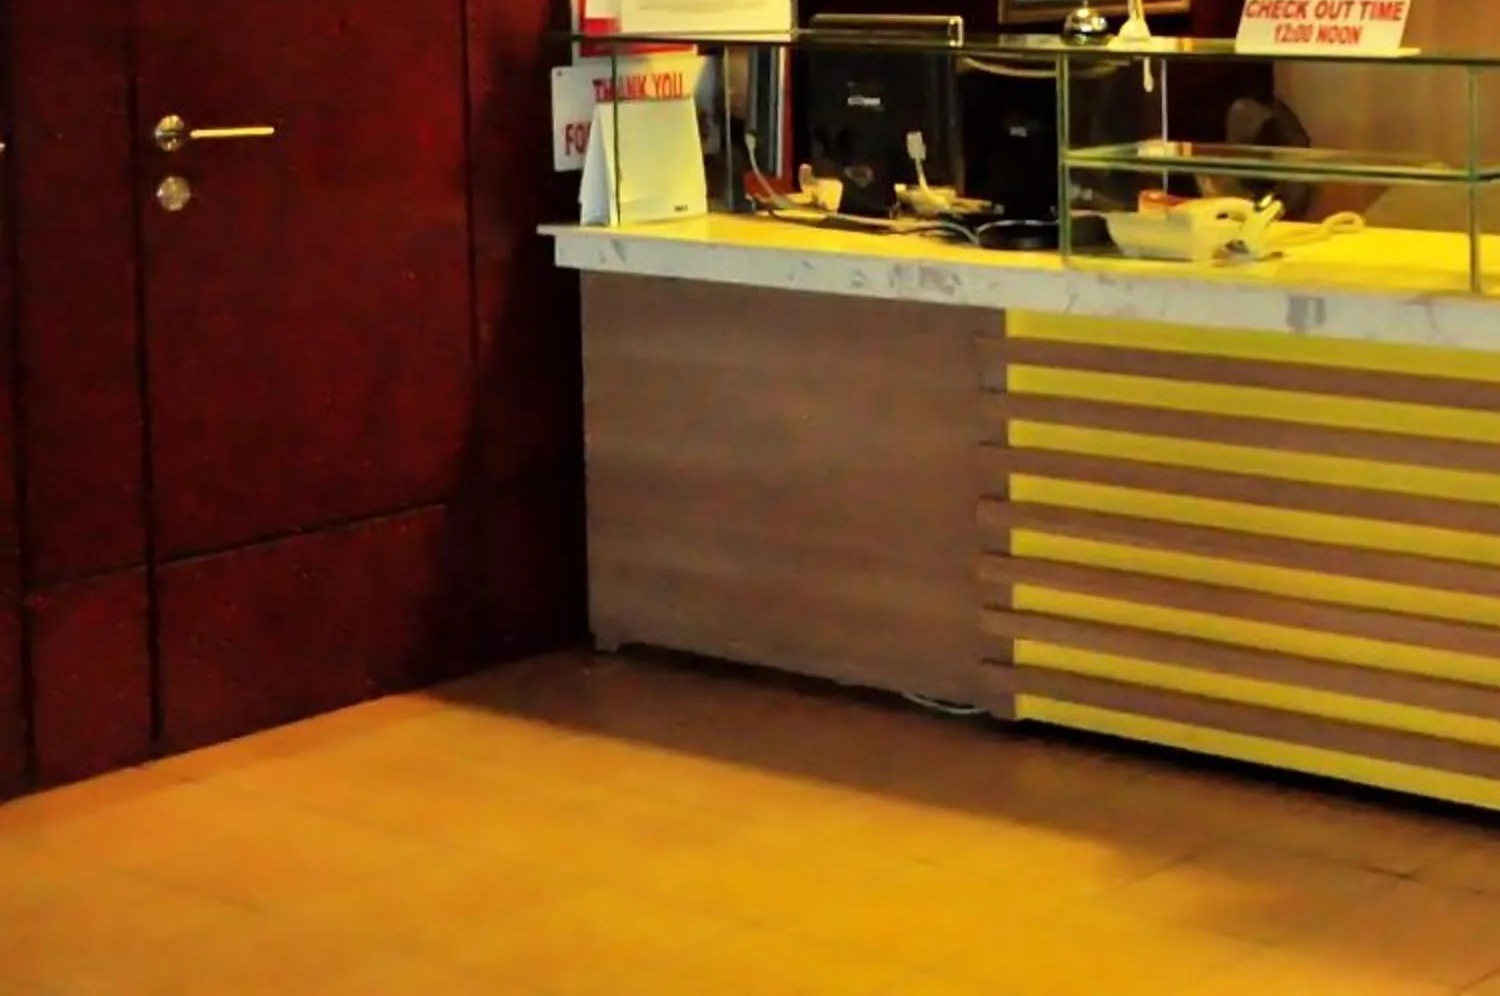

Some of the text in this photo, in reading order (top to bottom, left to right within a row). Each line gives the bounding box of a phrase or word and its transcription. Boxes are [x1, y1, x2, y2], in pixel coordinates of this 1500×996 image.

[1245, 0, 1405, 20] CHECK OUT TIME
[1273, 24, 1360, 45] 12:00 NOON
[592, 72, 683, 102] THANK YOU
[565, 122, 592, 155] FO
